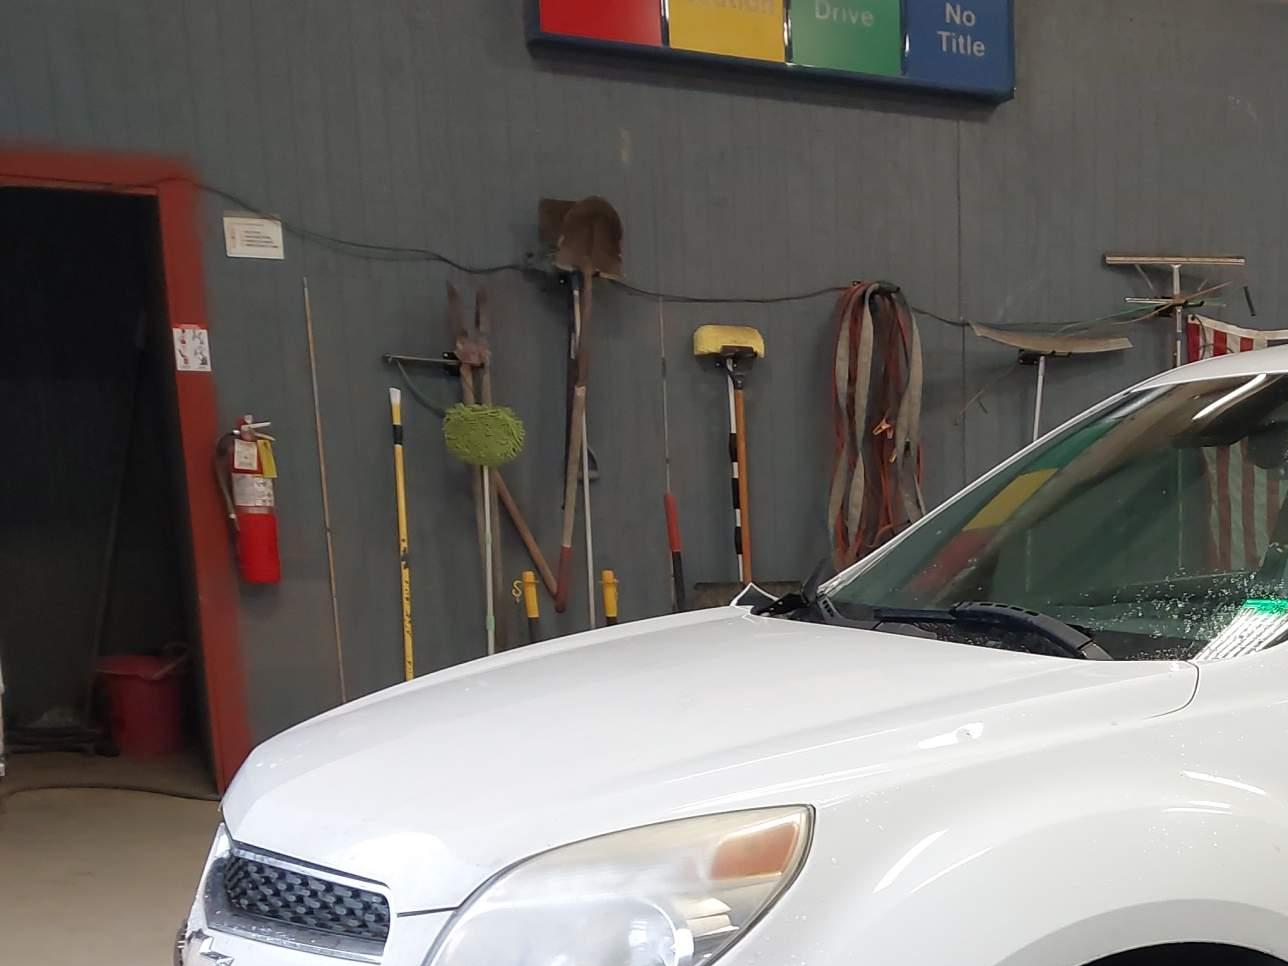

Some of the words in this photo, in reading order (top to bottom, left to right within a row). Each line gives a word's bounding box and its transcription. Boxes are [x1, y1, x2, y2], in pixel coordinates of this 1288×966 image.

[815, 0, 875, 27] Drive
[944, 2, 976, 27] No
[937, 30, 985, 57] Title
